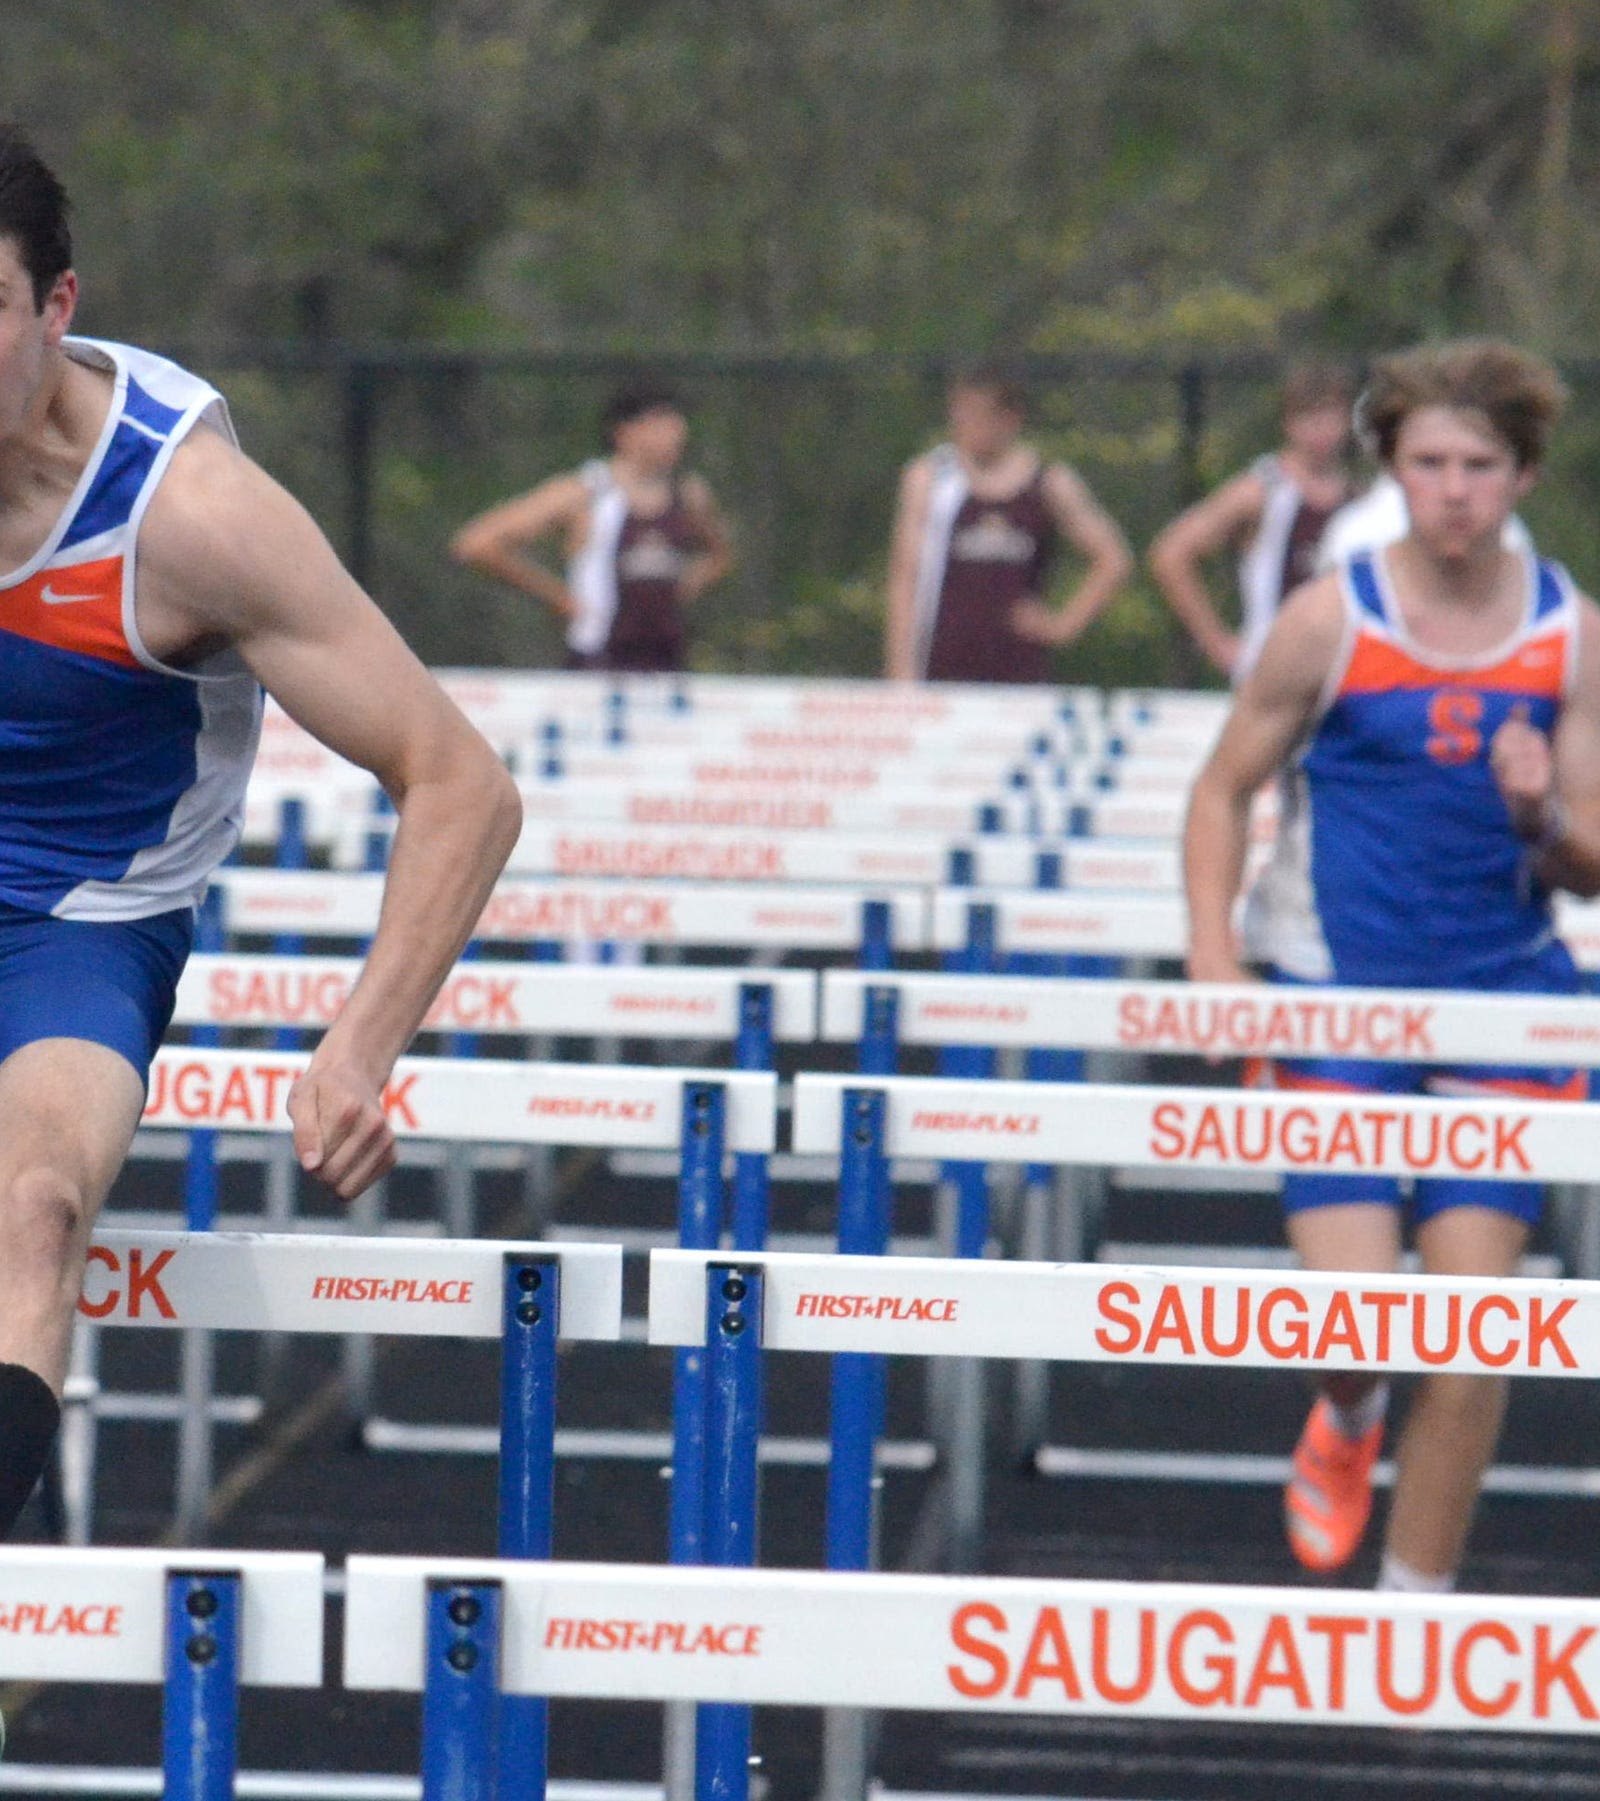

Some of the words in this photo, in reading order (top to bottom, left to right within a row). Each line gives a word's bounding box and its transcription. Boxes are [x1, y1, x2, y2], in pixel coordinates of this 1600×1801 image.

[1426, 686, 1484, 766] S
[1117, 993, 1435, 1055] SAUGATUCK
[1150, 1101, 1533, 1172] SAUGATUCK
[312, 1277, 386, 1302] FIRST
[391, 1281, 473, 1305] PLACE
[796, 1294, 868, 1319] FIRST
[874, 1297, 959, 1322] PLACE
[1094, 1281, 1579, 1369] SAUGATUCK
[11, 1603, 123, 1636] PLACE
[545, 1618, 643, 1652] FIRST
[650, 1622, 762, 1656] PLACE
[947, 1601, 1600, 1720] SAUGATUCK
